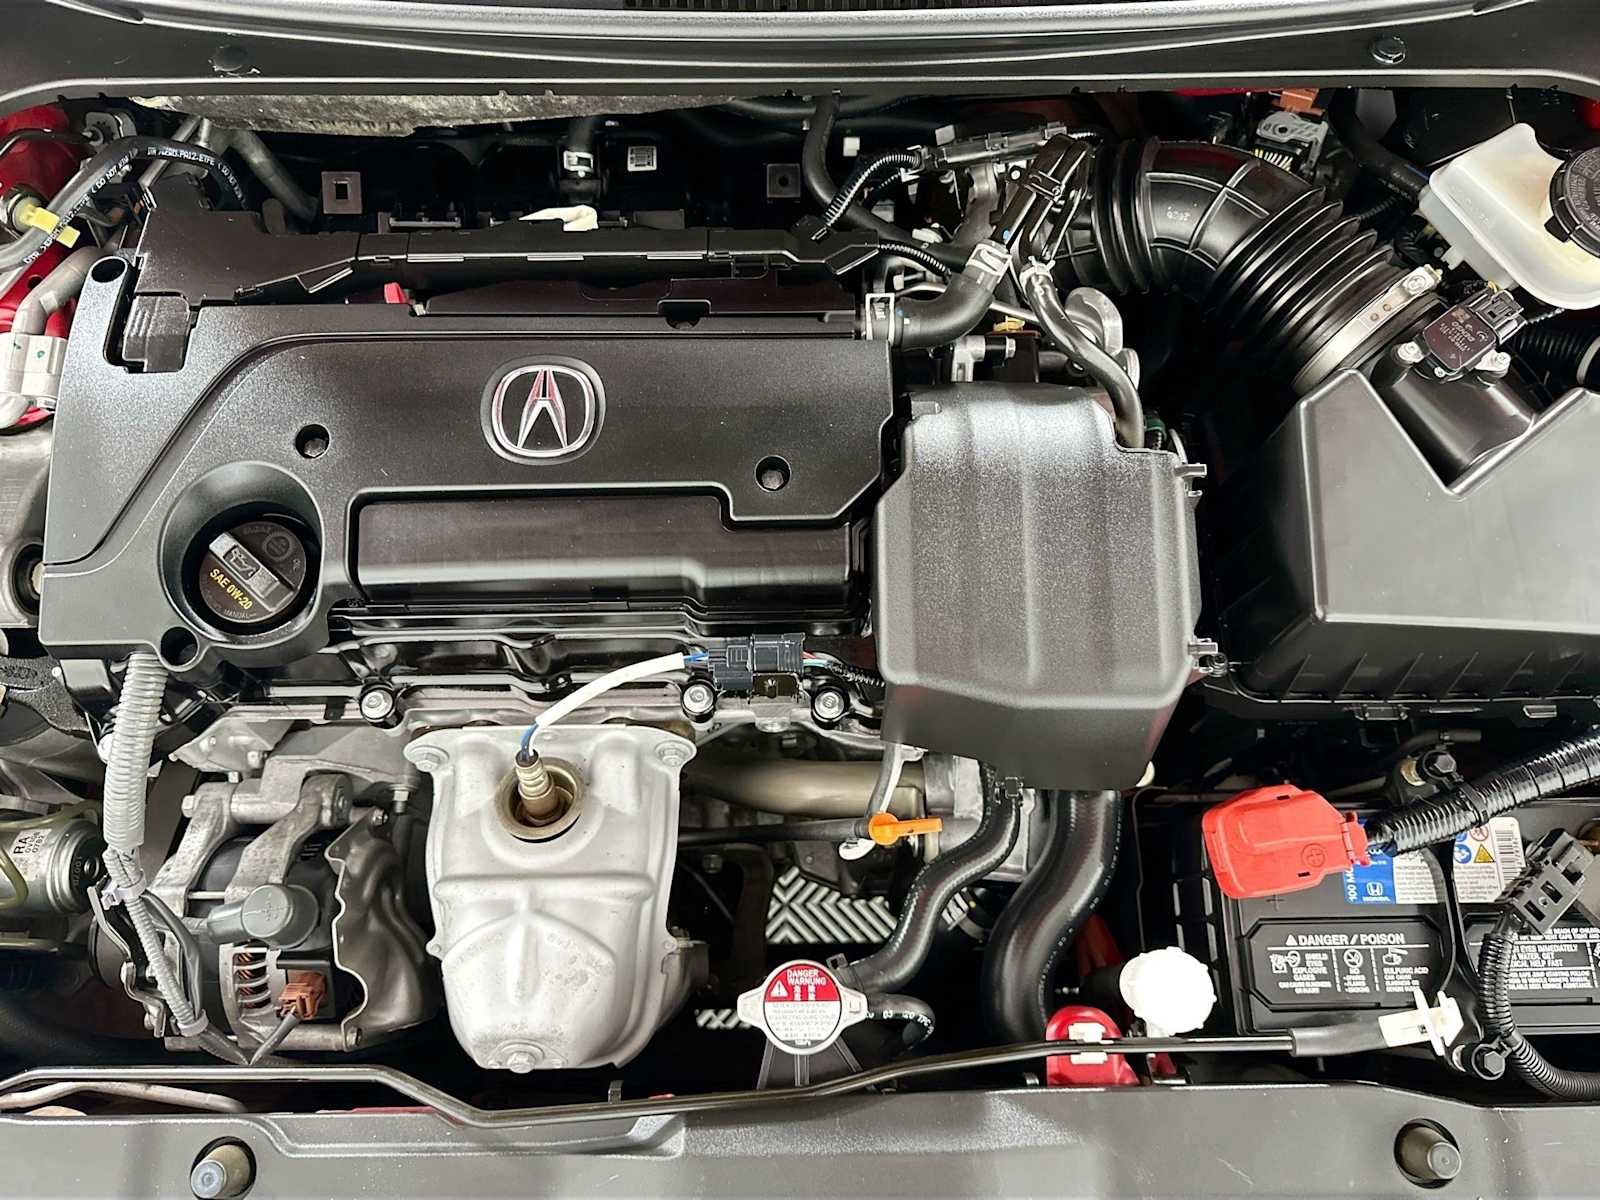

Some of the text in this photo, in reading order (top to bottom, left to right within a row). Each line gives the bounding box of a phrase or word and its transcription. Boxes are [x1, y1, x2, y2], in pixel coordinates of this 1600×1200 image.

[210, 568, 253, 610] SAE 0W-20
[13, 836, 30, 854] RA
[1297, 934, 1350, 946] DANGER
[1360, 932, 1406, 945] POISON
[1520, 944, 1537, 953] EYES
[1537, 943, 1578, 953] IMMEDIATELY
[1541, 952, 1555, 960] GET
[1530, 959, 1546, 967] HELP
[1547, 959, 1563, 967] FAST
[786, 969, 819, 978] DANGER
[1413, 966, 1429, 975] ACID
[787, 976, 827, 986] WARNUNG
